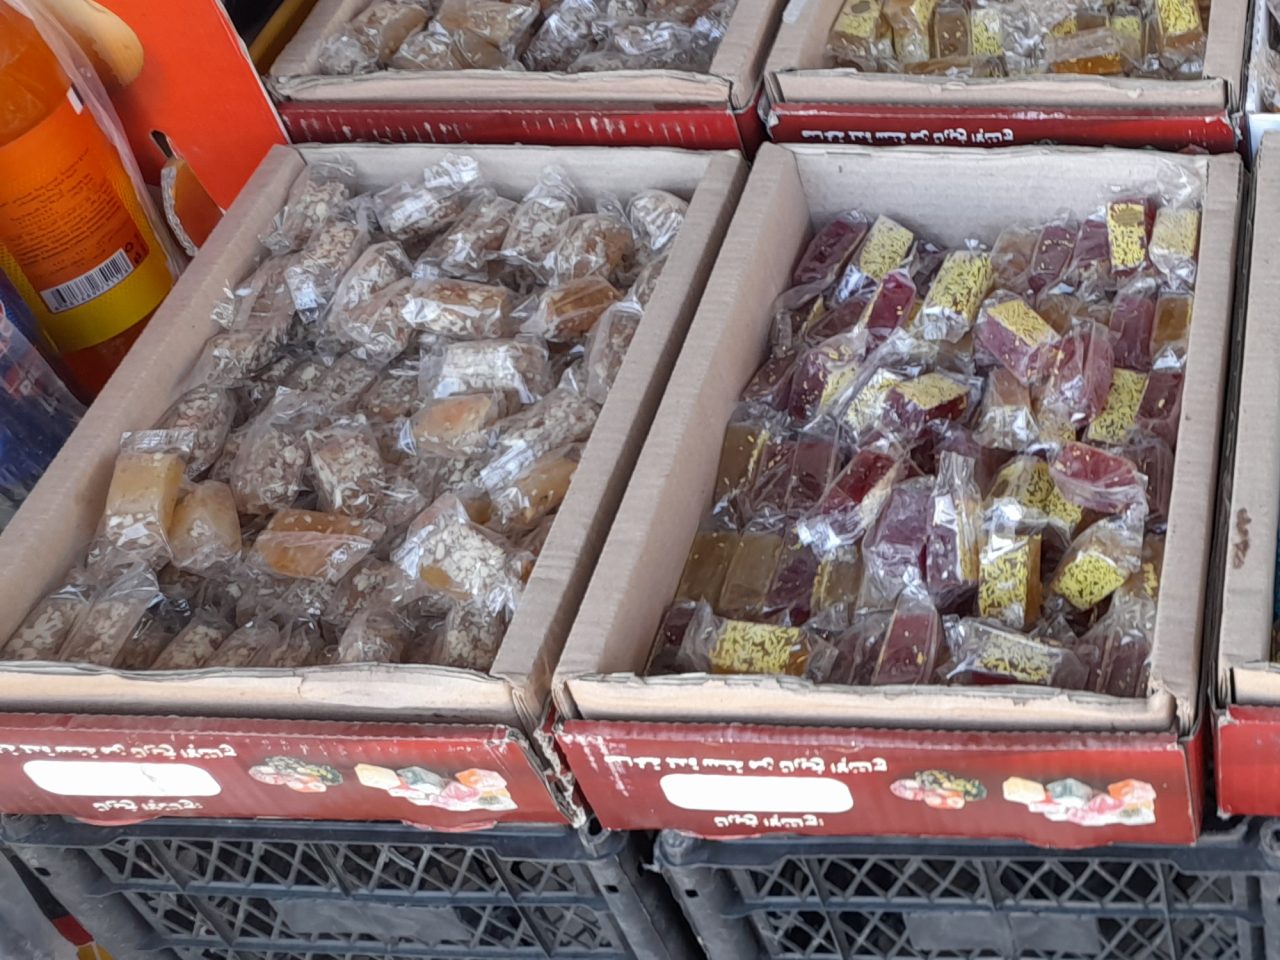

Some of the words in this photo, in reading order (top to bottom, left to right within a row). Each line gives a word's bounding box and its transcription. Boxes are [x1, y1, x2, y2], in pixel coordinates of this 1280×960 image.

[876, 130, 907, 142] سنة
[910, 129, 930, 141] من
[933, 128, 967, 142] تاريخ
[100, 744, 126, 759] من
[131, 743, 176, 760] تاريخ
[702, 757, 744, 775] سنة
[748, 756, 775, 771] من
[779, 756, 826, 775] تاريخ
[92, 799, 138, 813] تاريخ
[714, 814, 759, 828] تاريخ
